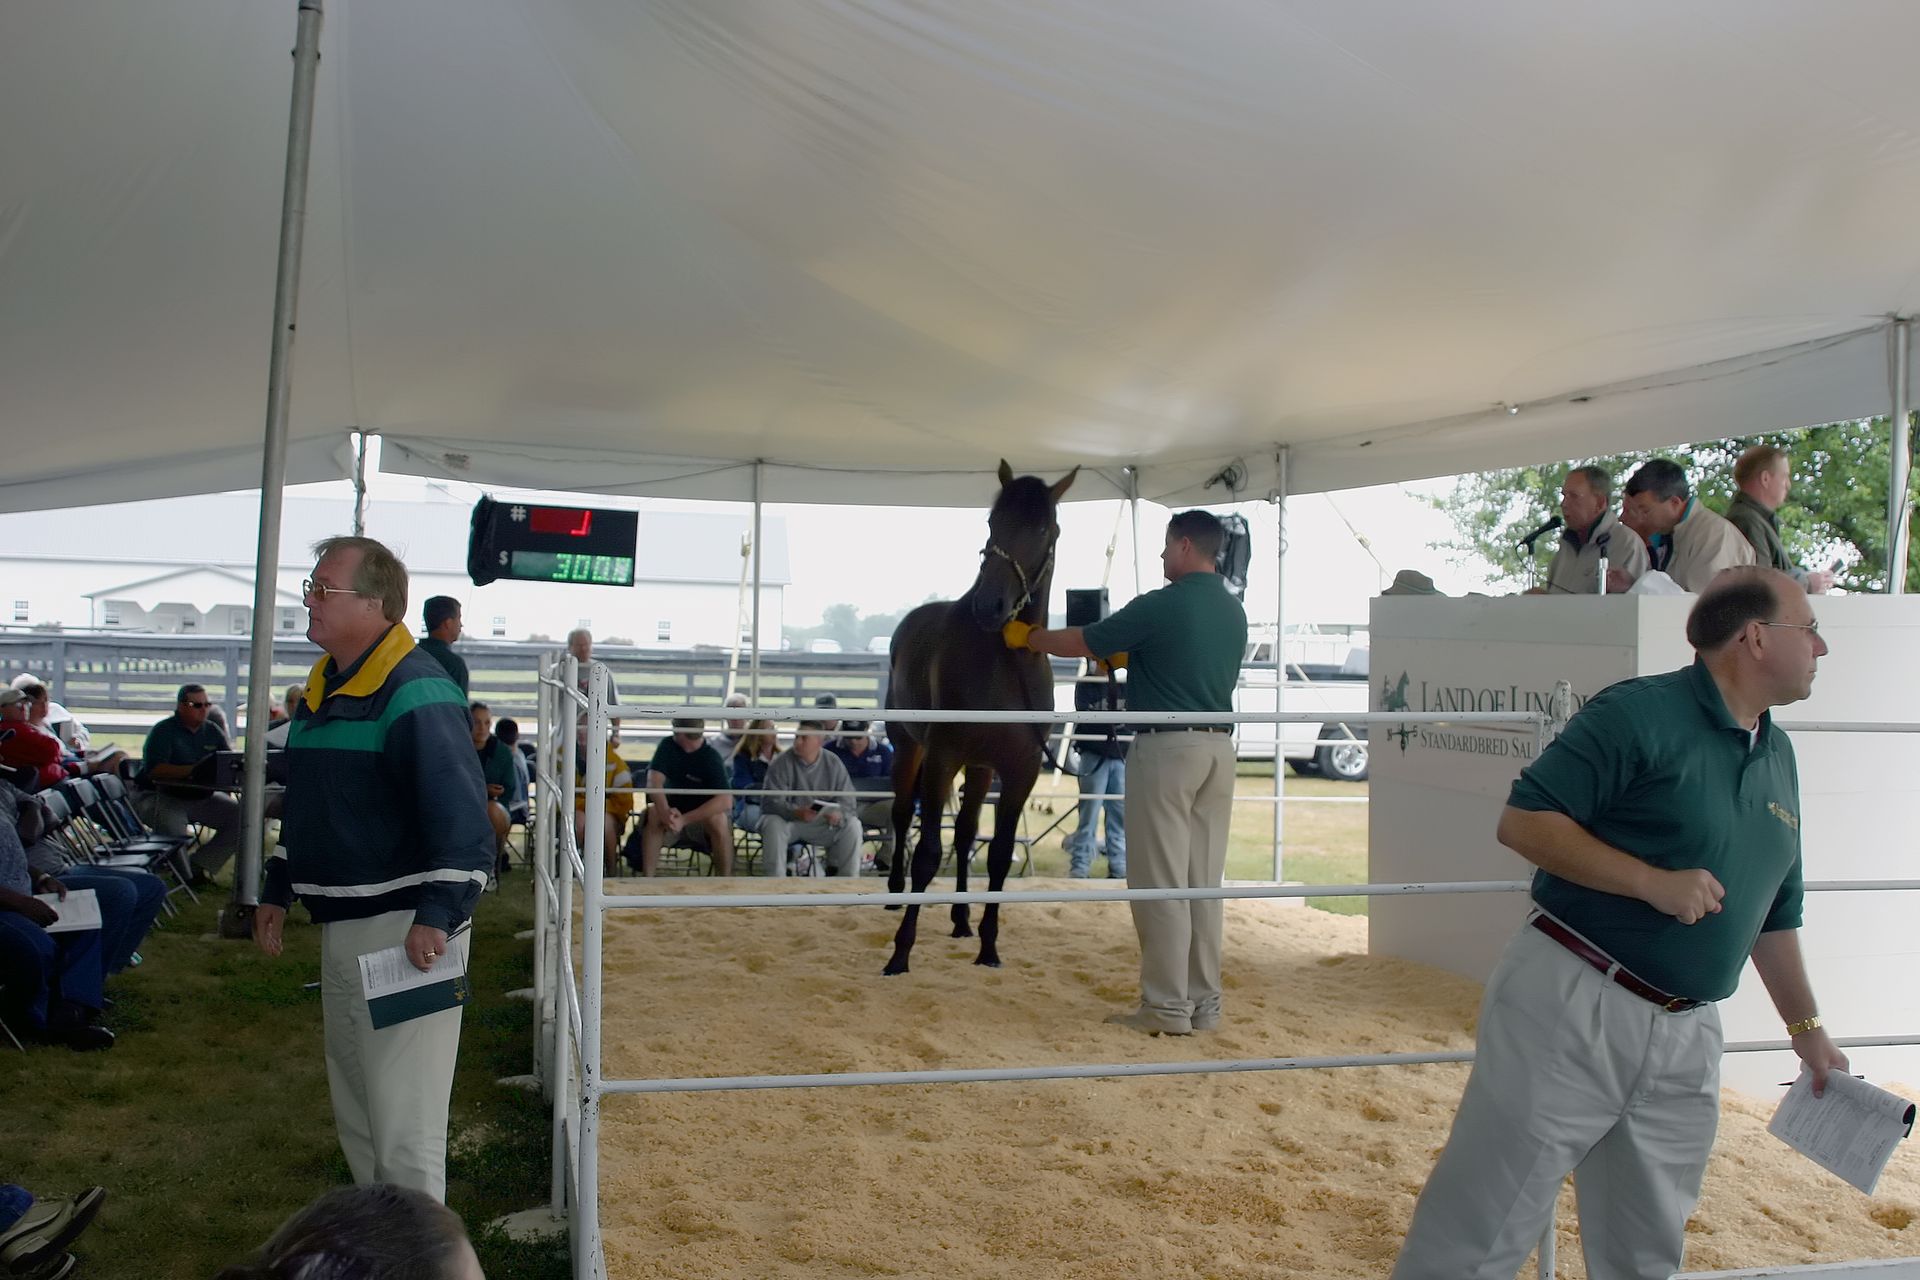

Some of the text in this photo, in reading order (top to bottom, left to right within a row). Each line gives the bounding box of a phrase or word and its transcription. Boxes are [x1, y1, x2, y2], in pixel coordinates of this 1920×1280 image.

[1421, 681, 1475, 712] LAND
[1478, 688, 1505, 712] OF
[1421, 729, 1534, 759] STANDARDBRED SAL
